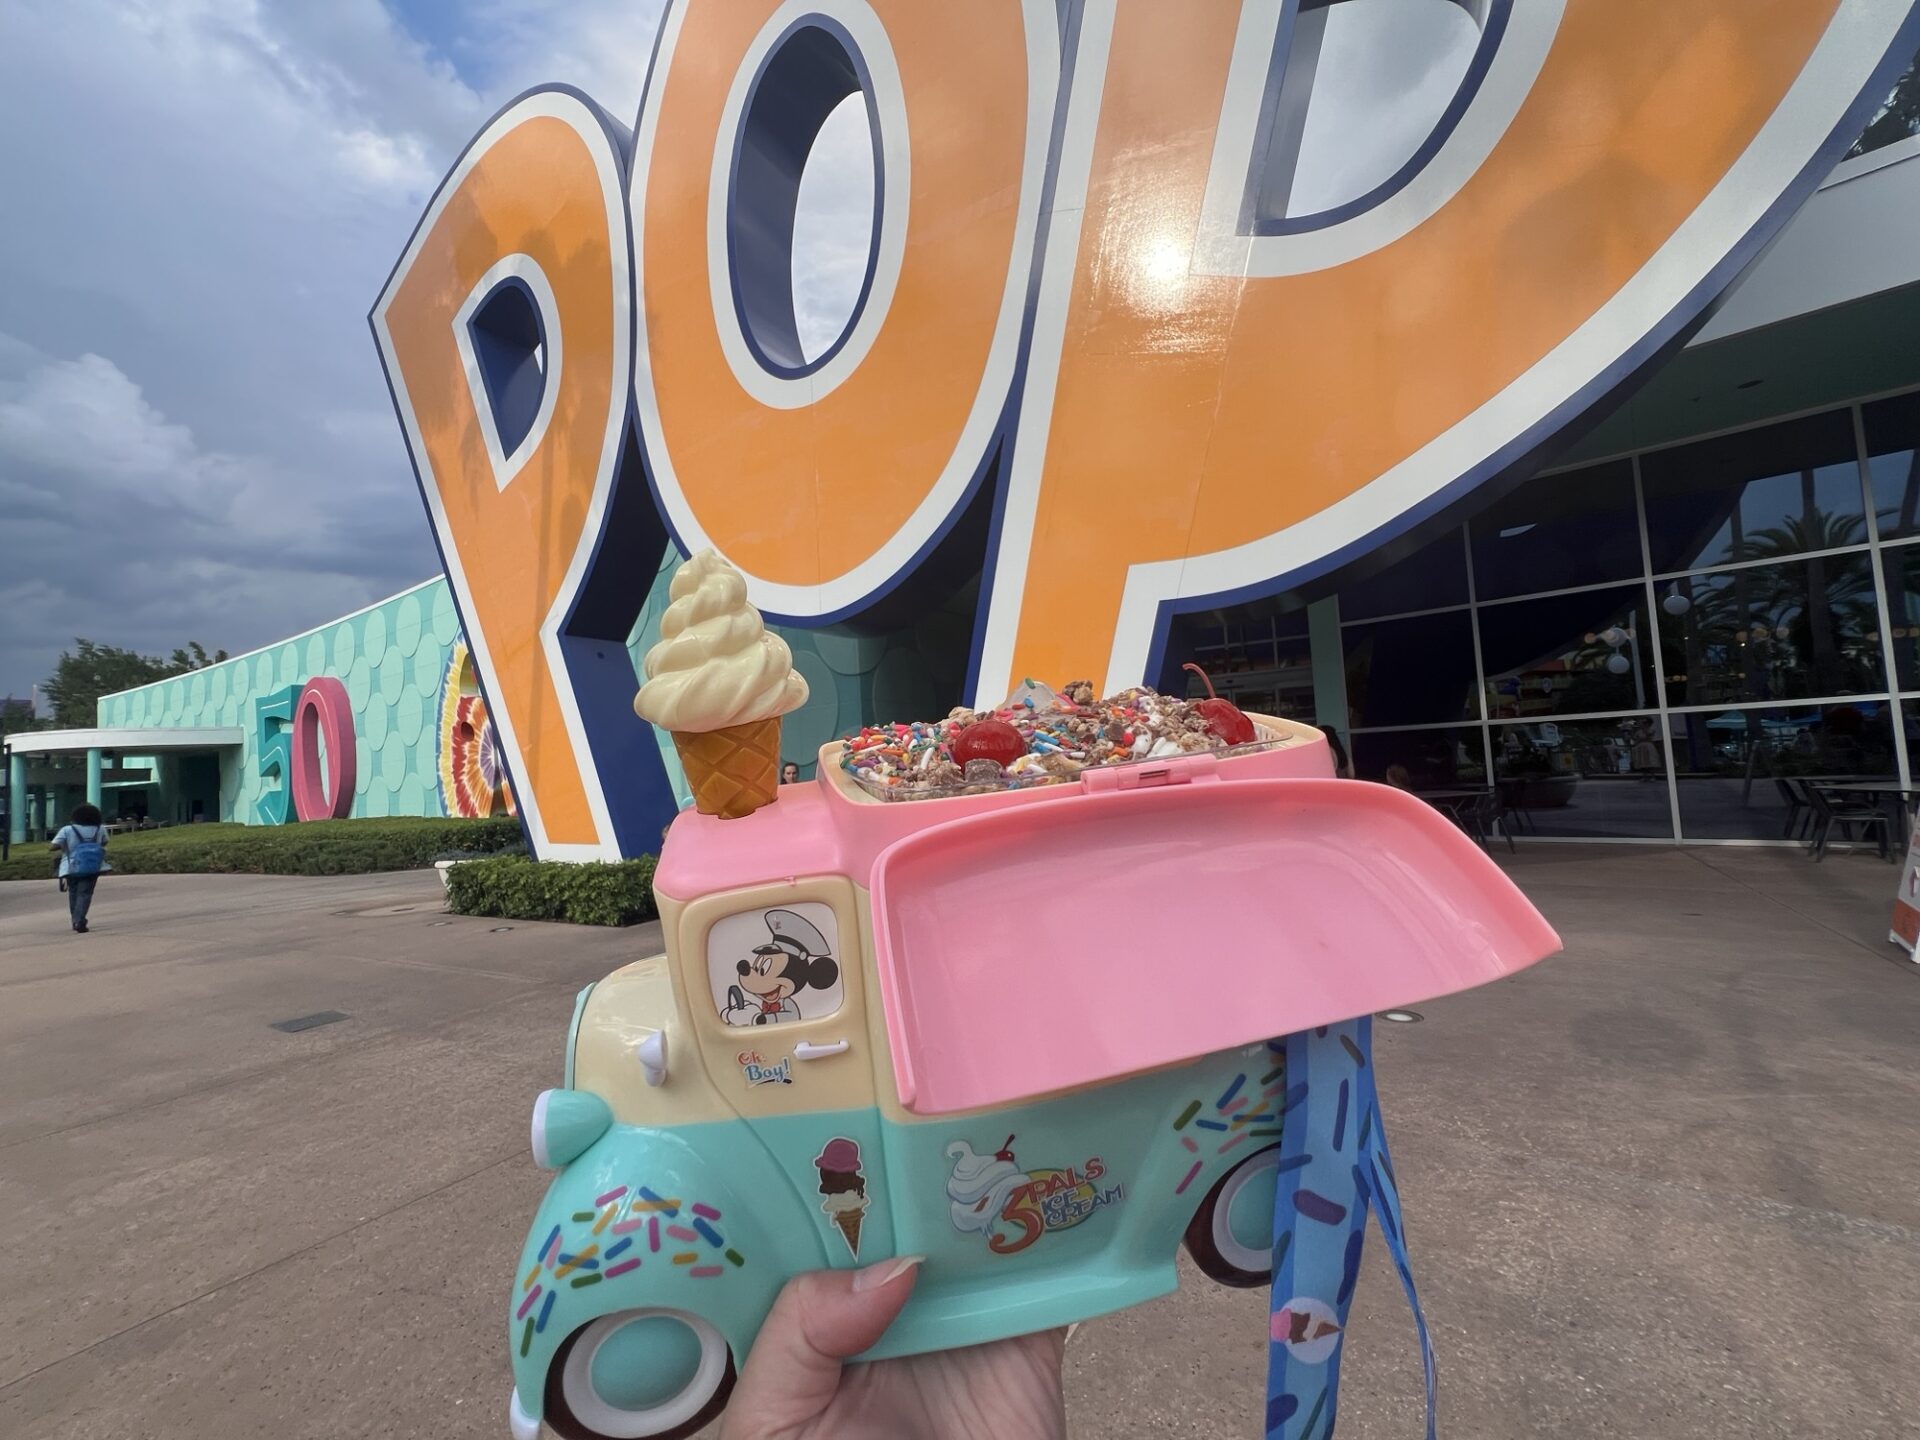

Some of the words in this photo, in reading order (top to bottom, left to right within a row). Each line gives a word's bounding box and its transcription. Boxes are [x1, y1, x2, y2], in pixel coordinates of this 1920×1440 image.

[371, 0, 1920, 864] POP
[255, 677, 357, 826] 50
[745, 1058, 790, 1083] Boy!
[1024, 1157, 1105, 1204] PALS
[1041, 1189, 1079, 1215] ICE
[1045, 1184, 1123, 1228] CREAM
